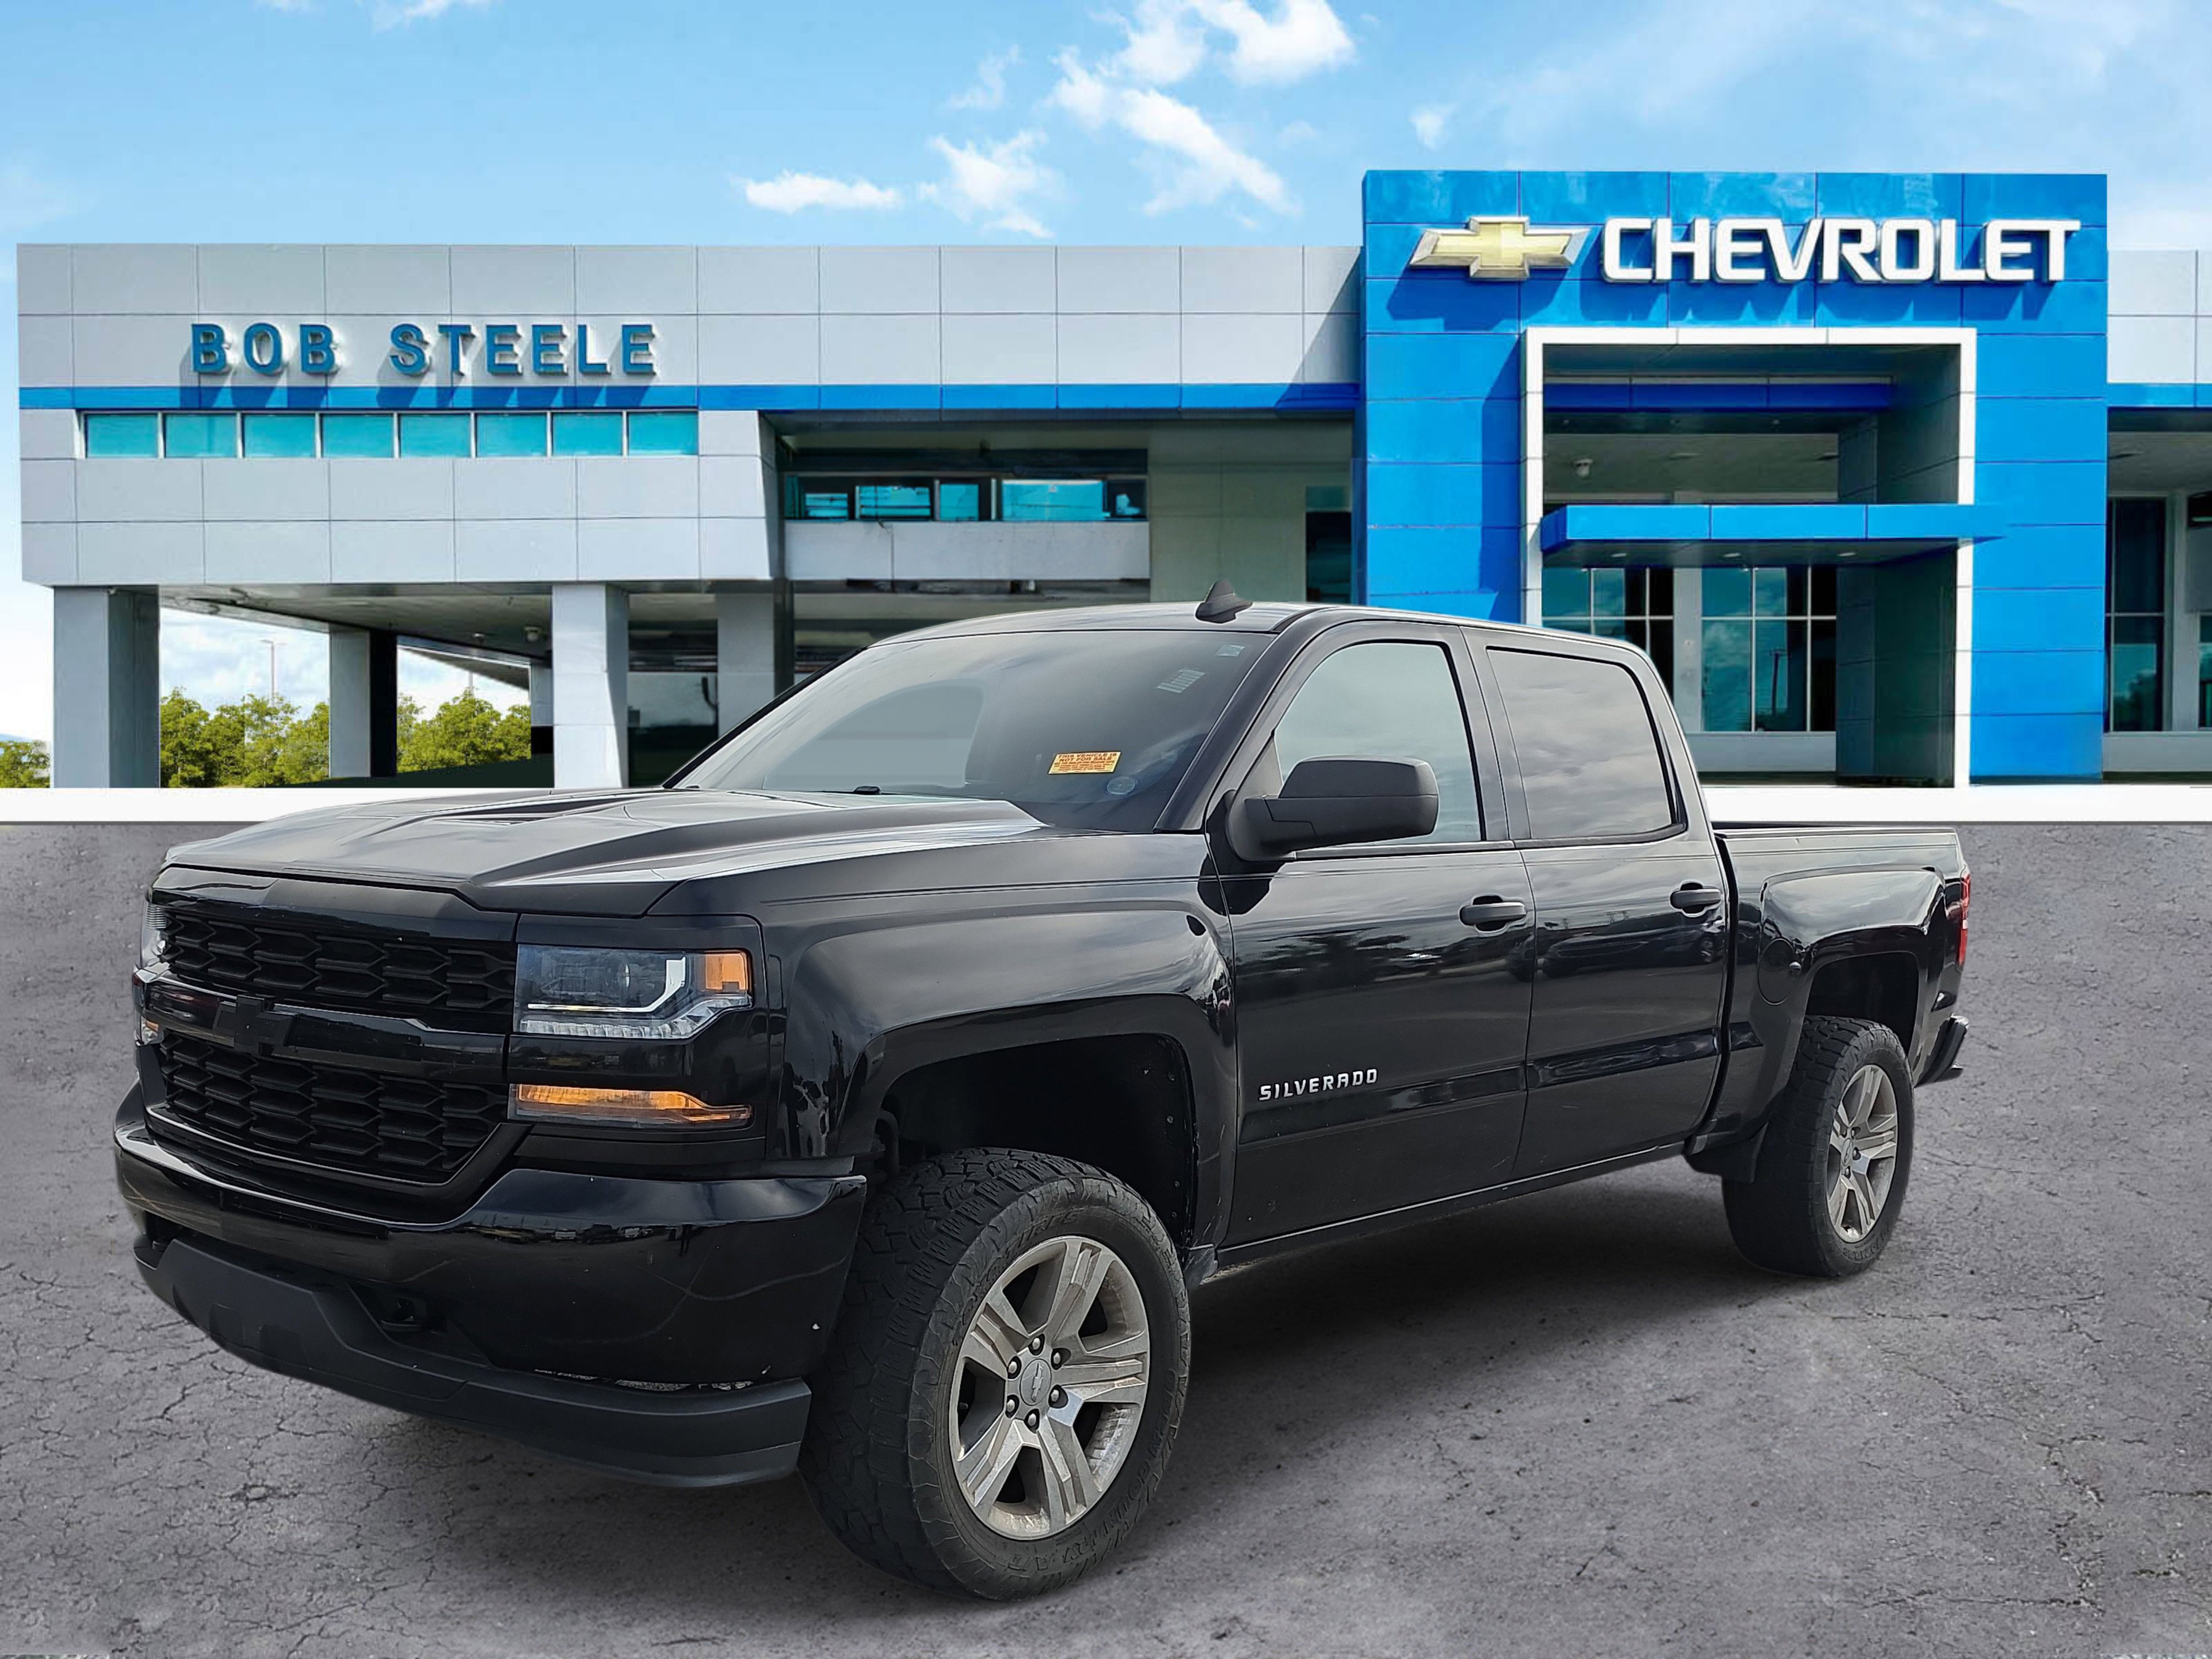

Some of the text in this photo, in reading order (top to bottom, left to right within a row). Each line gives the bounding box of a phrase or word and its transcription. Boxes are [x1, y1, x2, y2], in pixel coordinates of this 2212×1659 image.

[1601, 217, 2081, 283] CHEVROLET
[191, 322, 657, 376] BOB STEELE
[1258, 1068, 1378, 1102] SILVERADO
